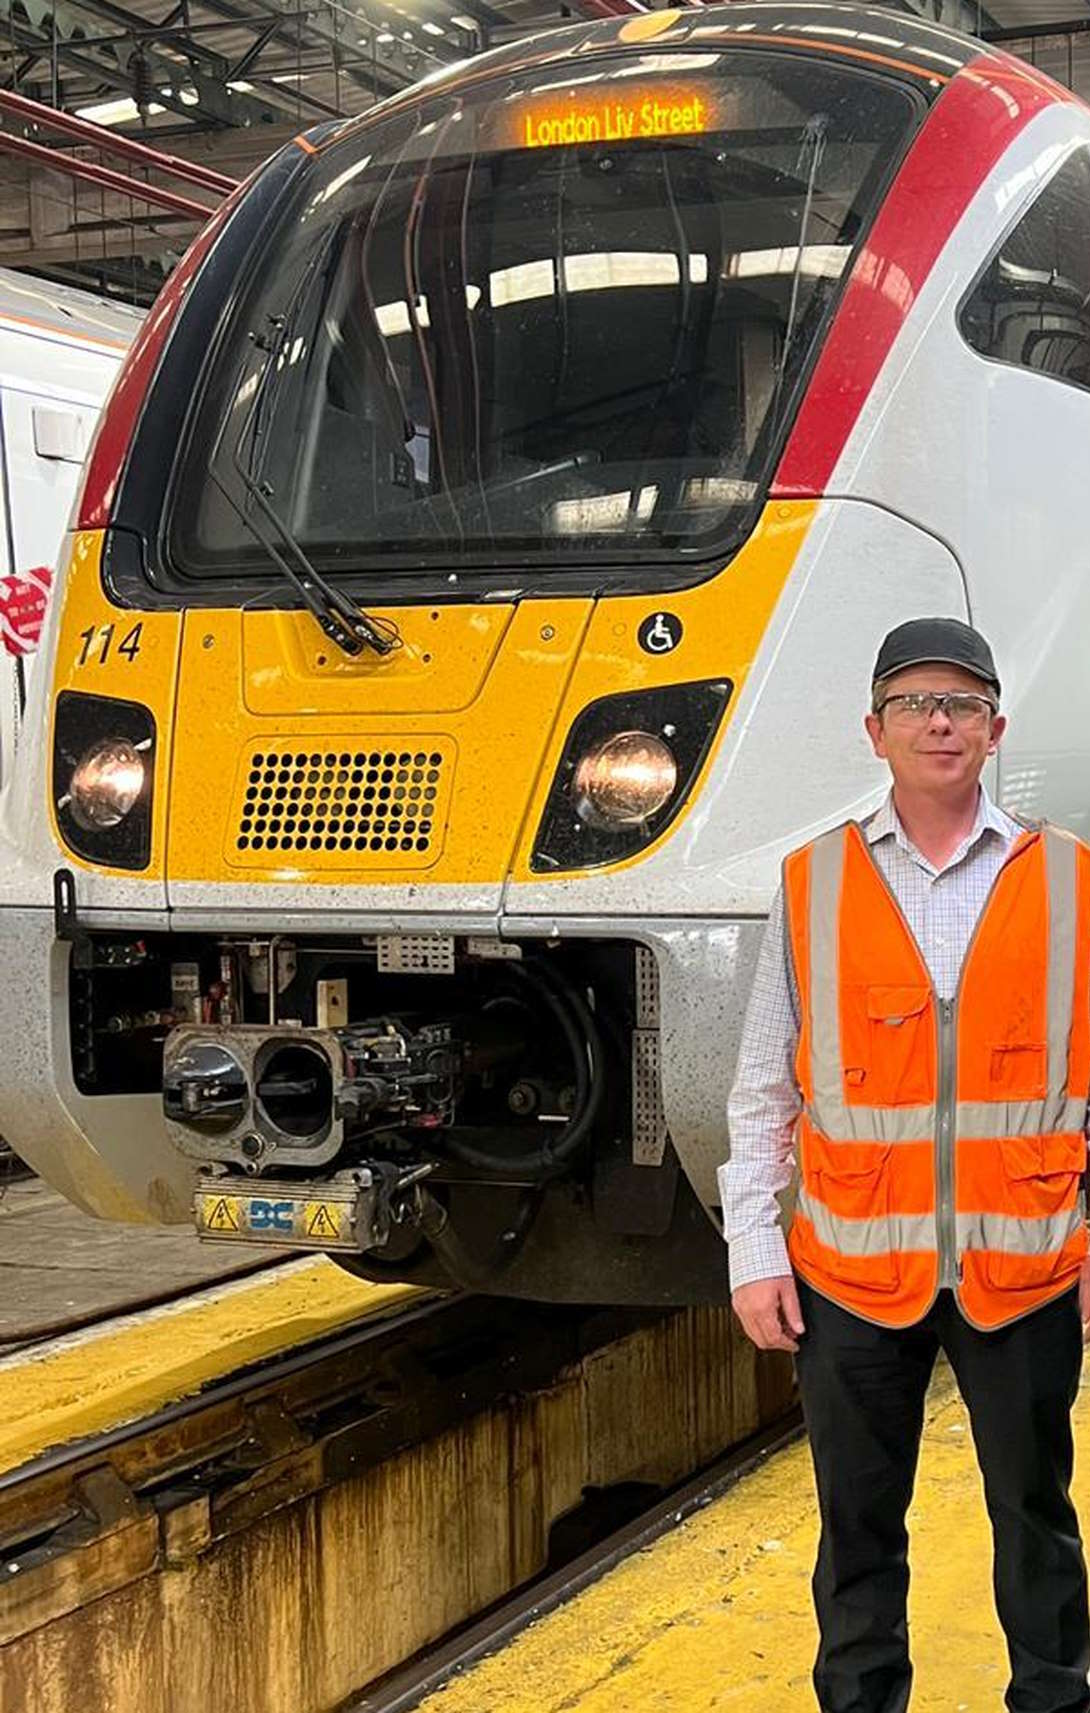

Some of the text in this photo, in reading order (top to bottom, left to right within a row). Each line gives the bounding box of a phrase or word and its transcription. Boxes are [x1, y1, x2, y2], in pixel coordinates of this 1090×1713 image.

[525, 97, 705, 147] London Liv Street
[79, 621, 144, 666] 114
